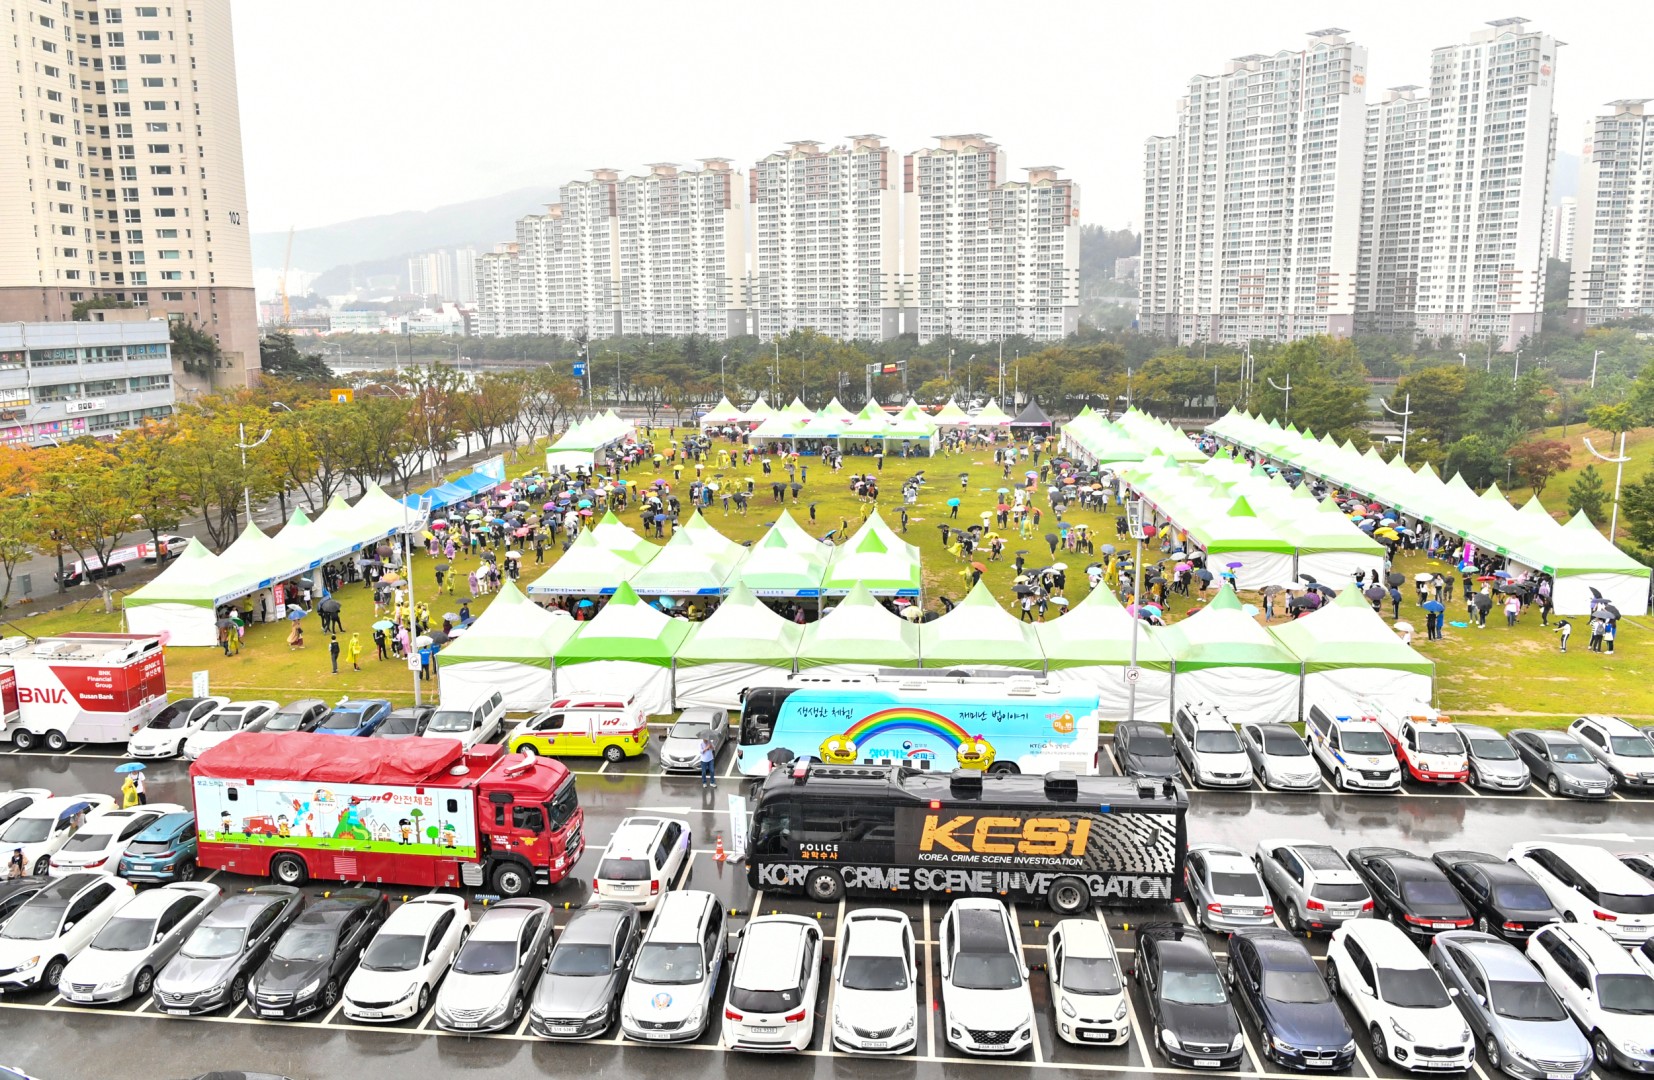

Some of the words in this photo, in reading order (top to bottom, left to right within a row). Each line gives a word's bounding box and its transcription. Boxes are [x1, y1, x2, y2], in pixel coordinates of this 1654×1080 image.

[229, 211, 240, 225] 102
[18, 687, 68, 704] BNK
[797, 706, 829, 718] 생생한
[831, 707, 854, 719] 체험!
[959, 711, 988, 722] 재미난
[991, 710, 1029, 723] 법이야기
[602, 717, 620, 726] 119
[869, 748, 909, 760] 찾아가는
[912, 752, 935, 760] 로파크
[799, 843, 839, 852] POLICE
[801, 851, 838, 860] 과학수사
[918, 853, 949, 862] KOREA
[951, 854, 980, 863] CRIME
[982, 855, 1012, 864] SCENE
[1014, 857, 1083, 866] INVESTIGATION
[758, 863, 829, 885] KOR
[840, 866, 911, 890] CRIME
[913, 868, 993, 893] SCENE
[996, 871, 1172, 899] INVEGATION
